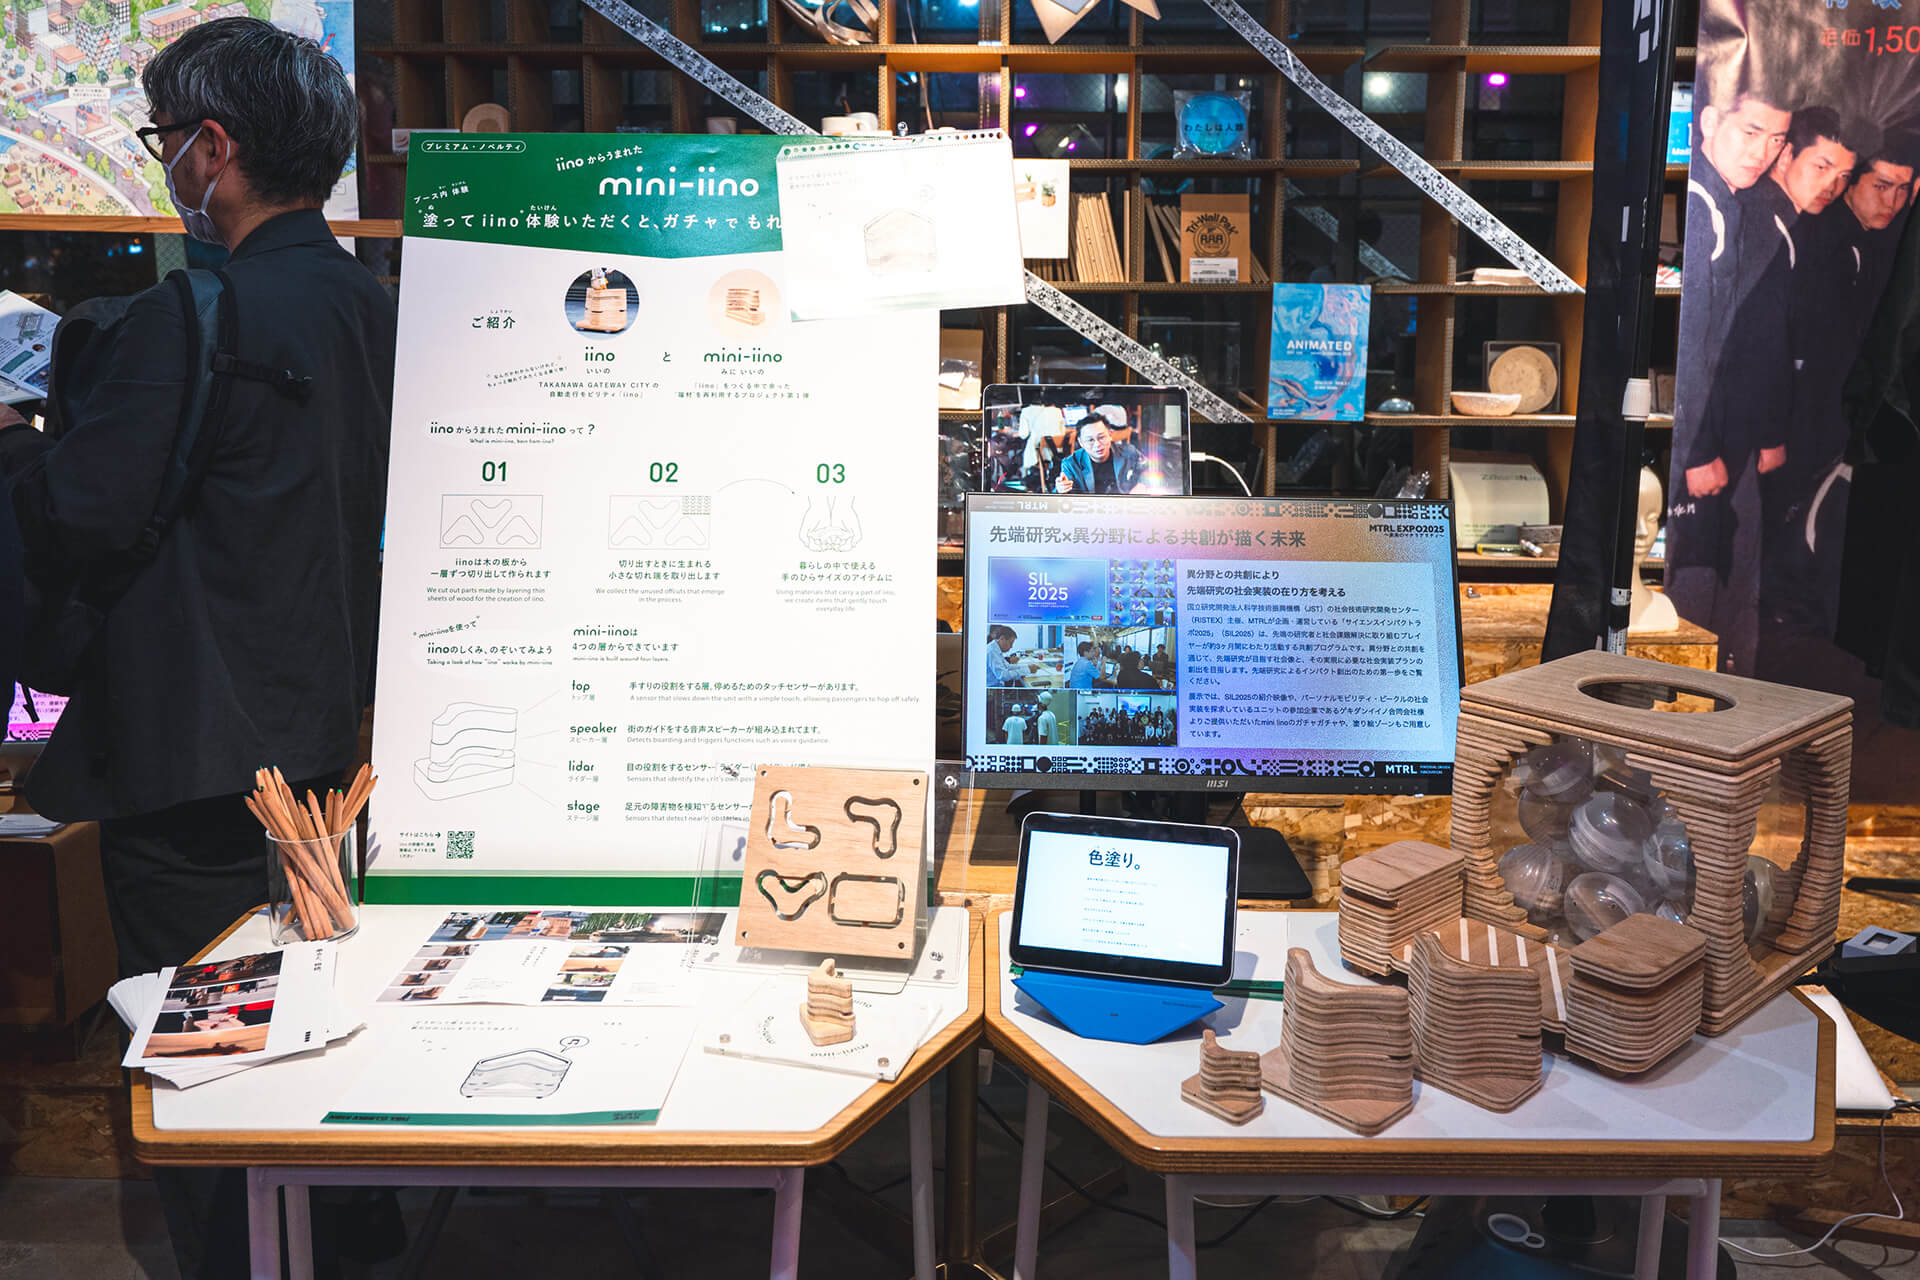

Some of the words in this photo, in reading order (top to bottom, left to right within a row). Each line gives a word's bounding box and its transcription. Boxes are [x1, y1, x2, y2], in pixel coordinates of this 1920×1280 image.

[599, 166, 759, 196] mini-iino
[472, 316, 516, 329] ご紹介
[1287, 340, 1352, 351] ANIMATED
[585, 346, 615, 361] iino
[663, 352, 671, 362] と
[704, 347, 782, 362] mini-iino
[482, 461, 507, 482] 01
[649, 462, 679, 483] 02
[816, 463, 845, 484] 03
[1369, 525, 1395, 533] MTRL
[1397, 525, 1444, 533] EXPO2025
[989, 525, 1306, 547] 先端研究×異分野による共創が描く未来
[455, 558, 528, 567] iinoは木の板から
[618, 560, 711, 569] 切り出すときに生まれる
[799, 561, 876, 570] 暮らしの中で使える
[430, 569, 551, 578] 一層ずつ切り出して作られます
[781, 573, 893, 582] 手のひらサイズのアイテムに
[1028, 572, 1053, 586] SIL
[1187, 569, 1280, 580] 異分野との共創により
[1028, 586, 1068, 601] 2025
[1187, 586, 1346, 597] 先端研究の社会実装の在り方を考える
[573, 625, 638, 637] mini-iinoは
[572, 642, 678, 651] 4つの層からできています
[572, 680, 590, 694] top
[1190, 677, 1221, 685] ください。
[570, 722, 617, 735] speaker
[1190, 730, 1221, 739] ています。
[568, 760, 594, 773] lidar
[1386, 764, 1418, 774] MTRL
[567, 800, 600, 814] stage
[1088, 849, 1141, 870] 色塗り。
